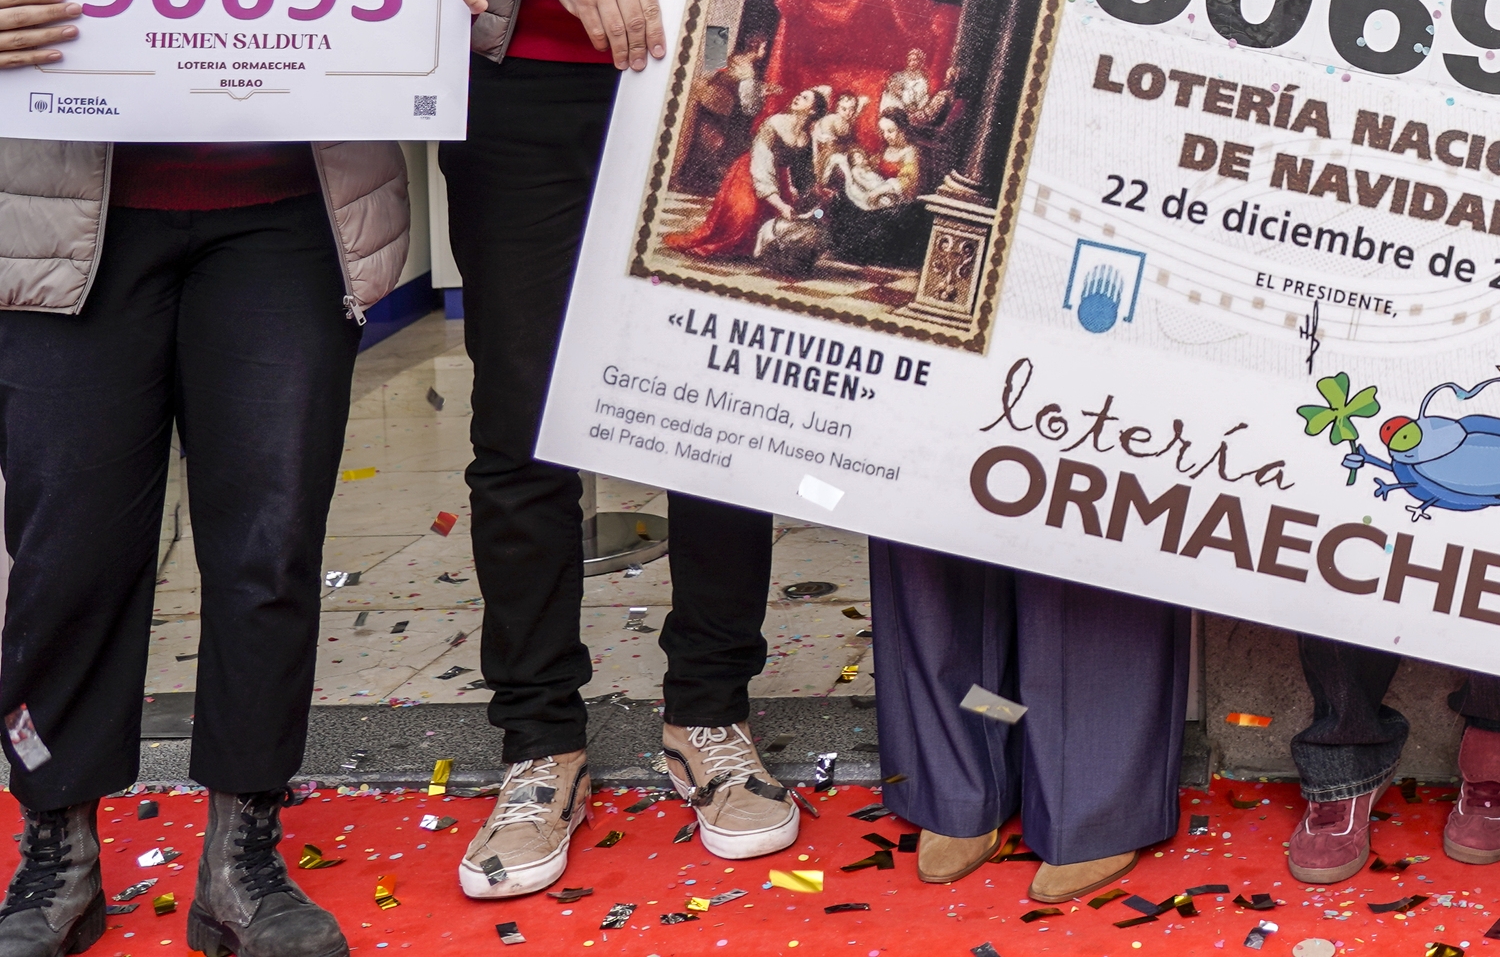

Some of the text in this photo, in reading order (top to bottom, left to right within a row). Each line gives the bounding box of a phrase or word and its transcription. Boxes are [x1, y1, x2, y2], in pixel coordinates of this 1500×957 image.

[146, 31, 332, 50] HEMEN SALDUTA
[178, 61, 306, 70] LOTERIA ORMAECHEA
[220, 79, 263, 88] BILBAO
[57, 96, 107, 106] LOTERÍA
[57, 106, 120, 115] NACIONAL
[1093, 55, 1331, 139] LOTERÍA
[1179, 133, 1253, 181] DE
[1101, 174, 1149, 212] 22
[1161, 187, 1209, 225] de
[1222, 200, 1415, 270] diciembre
[1428, 235, 1477, 285] de
[1256, 272, 1399, 318] EL PRESIDENTE,
[668, 308, 931, 387] «LA NATIVIDAD DE
[707, 344, 876, 402] LA VIRGEN»
[602, 365, 853, 440] García de Miranda, Juan
[981, 357, 1296, 491] lotería
[589, 423, 614, 441] del
[674, 441, 733, 468] Madrid
[595, 398, 901, 482] Imagen cedida por el Museo Nacional
